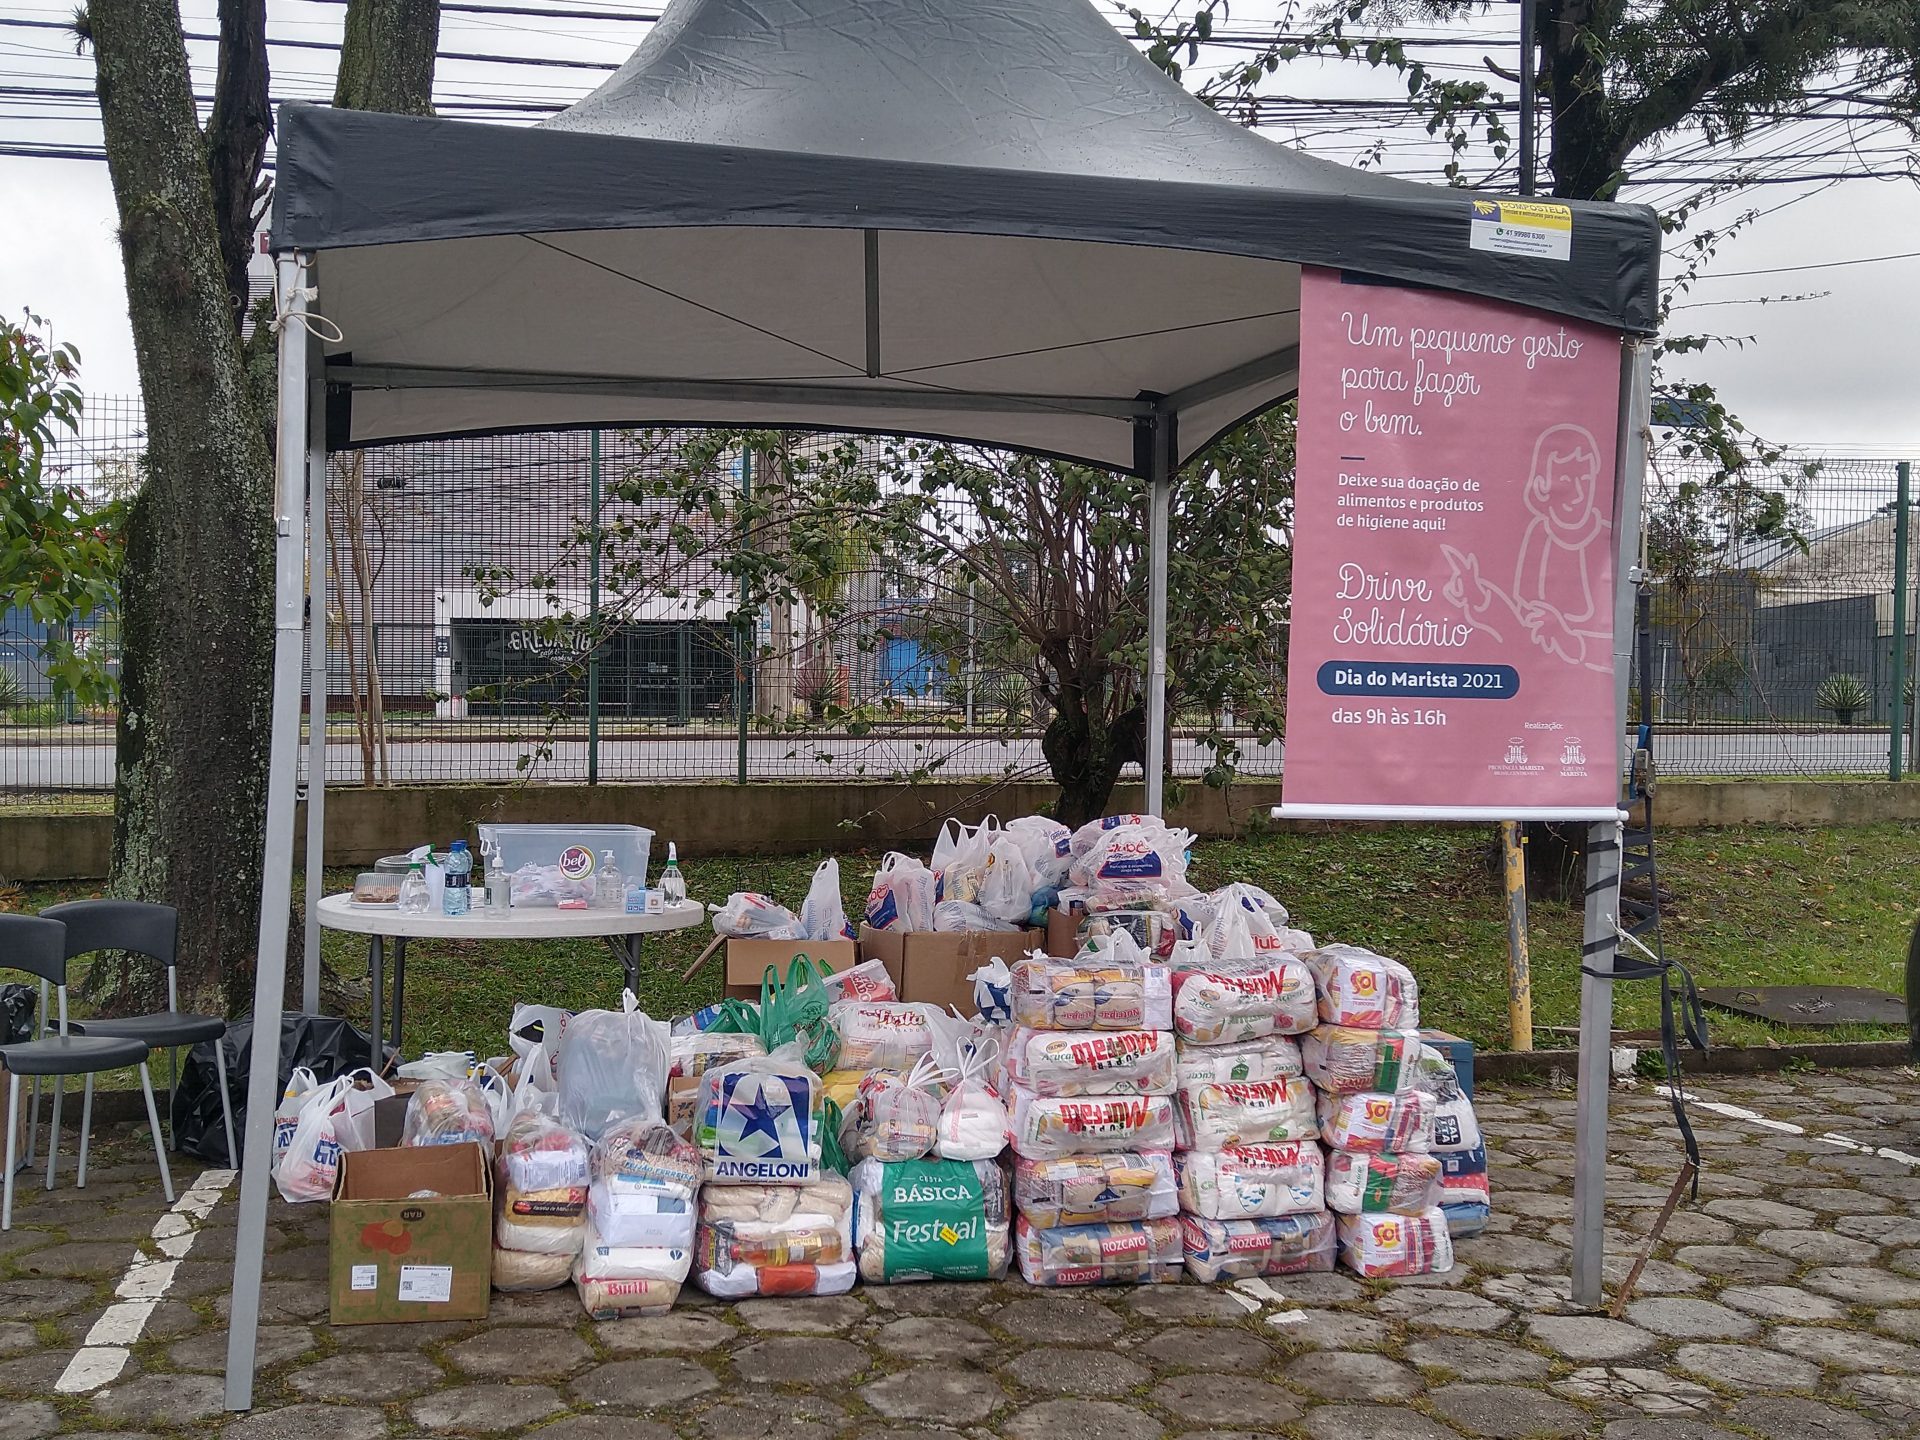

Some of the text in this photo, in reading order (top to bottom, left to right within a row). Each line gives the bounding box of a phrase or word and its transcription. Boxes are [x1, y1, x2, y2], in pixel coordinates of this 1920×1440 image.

[1341, 311, 1584, 369] Um pequeno gesto
[1341, 359, 1481, 407] para fazer
[1340, 400, 1423, 436] o bem.
[1338, 473, 1480, 493] Deixe sua doação de
[1337, 494, 1484, 512] alimentos e produtos
[1336, 514, 1446, 532] de higiene aqui!
[1336, 563, 1432, 602] Drive
[1333, 607, 1473, 647] Solidário
[1335, 670, 1503, 689] Dia do Marista 2021
[1332, 708, 1446, 725] das 9h às 16h
[563, 853, 587, 867] bel
[1447, 1115, 1457, 1143] SAL
[716, 1161, 809, 1178] ANGELONI
[918, 1175, 943, 1183] CESTA
[893, 1183, 973, 1204] BÁSICA
[1102, 1235, 1147, 1253] ROZCATO
[1230, 1234, 1273, 1250] ROZCATO
